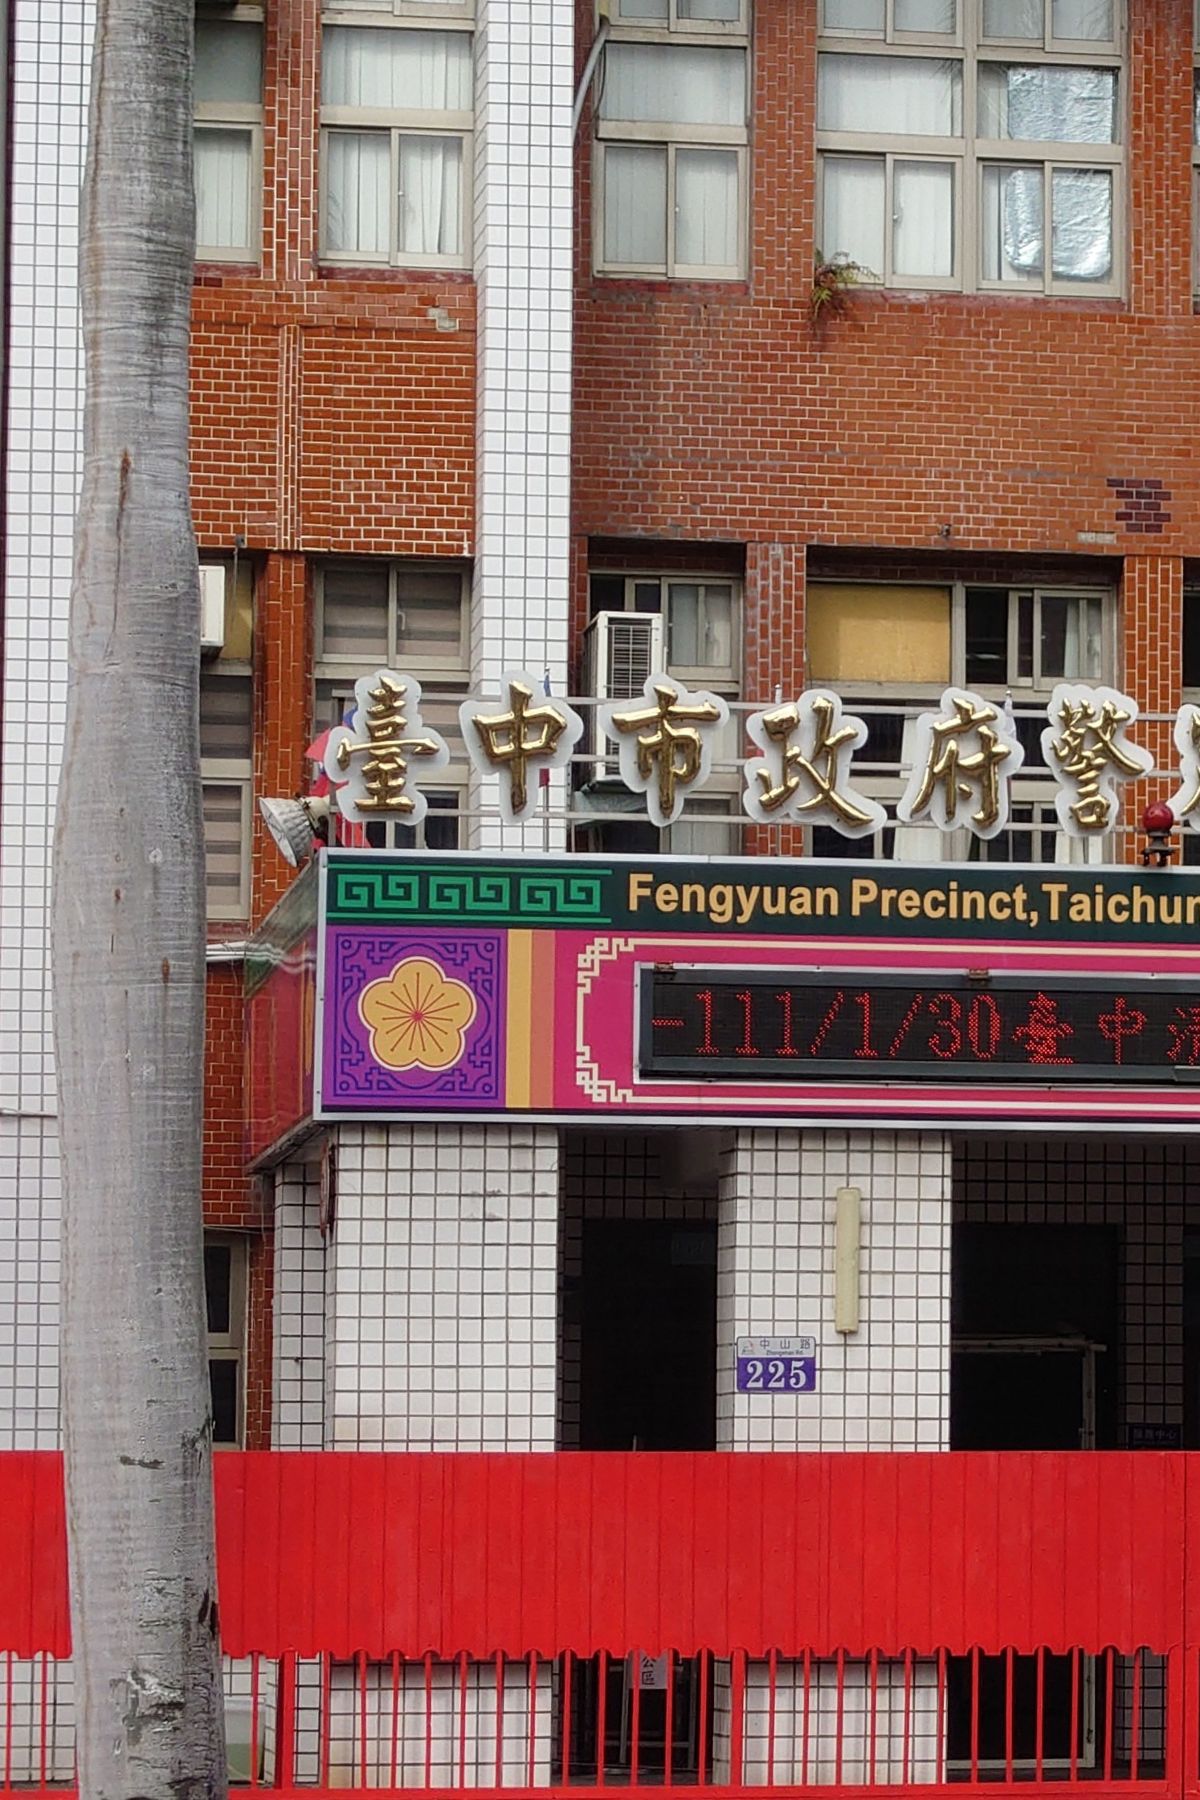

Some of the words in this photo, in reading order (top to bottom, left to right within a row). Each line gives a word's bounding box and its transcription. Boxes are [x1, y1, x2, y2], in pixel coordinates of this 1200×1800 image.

[629, 873, 839, 924] Fengyuan
[760, 1338, 811, 1350] 中山路
[746, 1360, 807, 1389] 225
